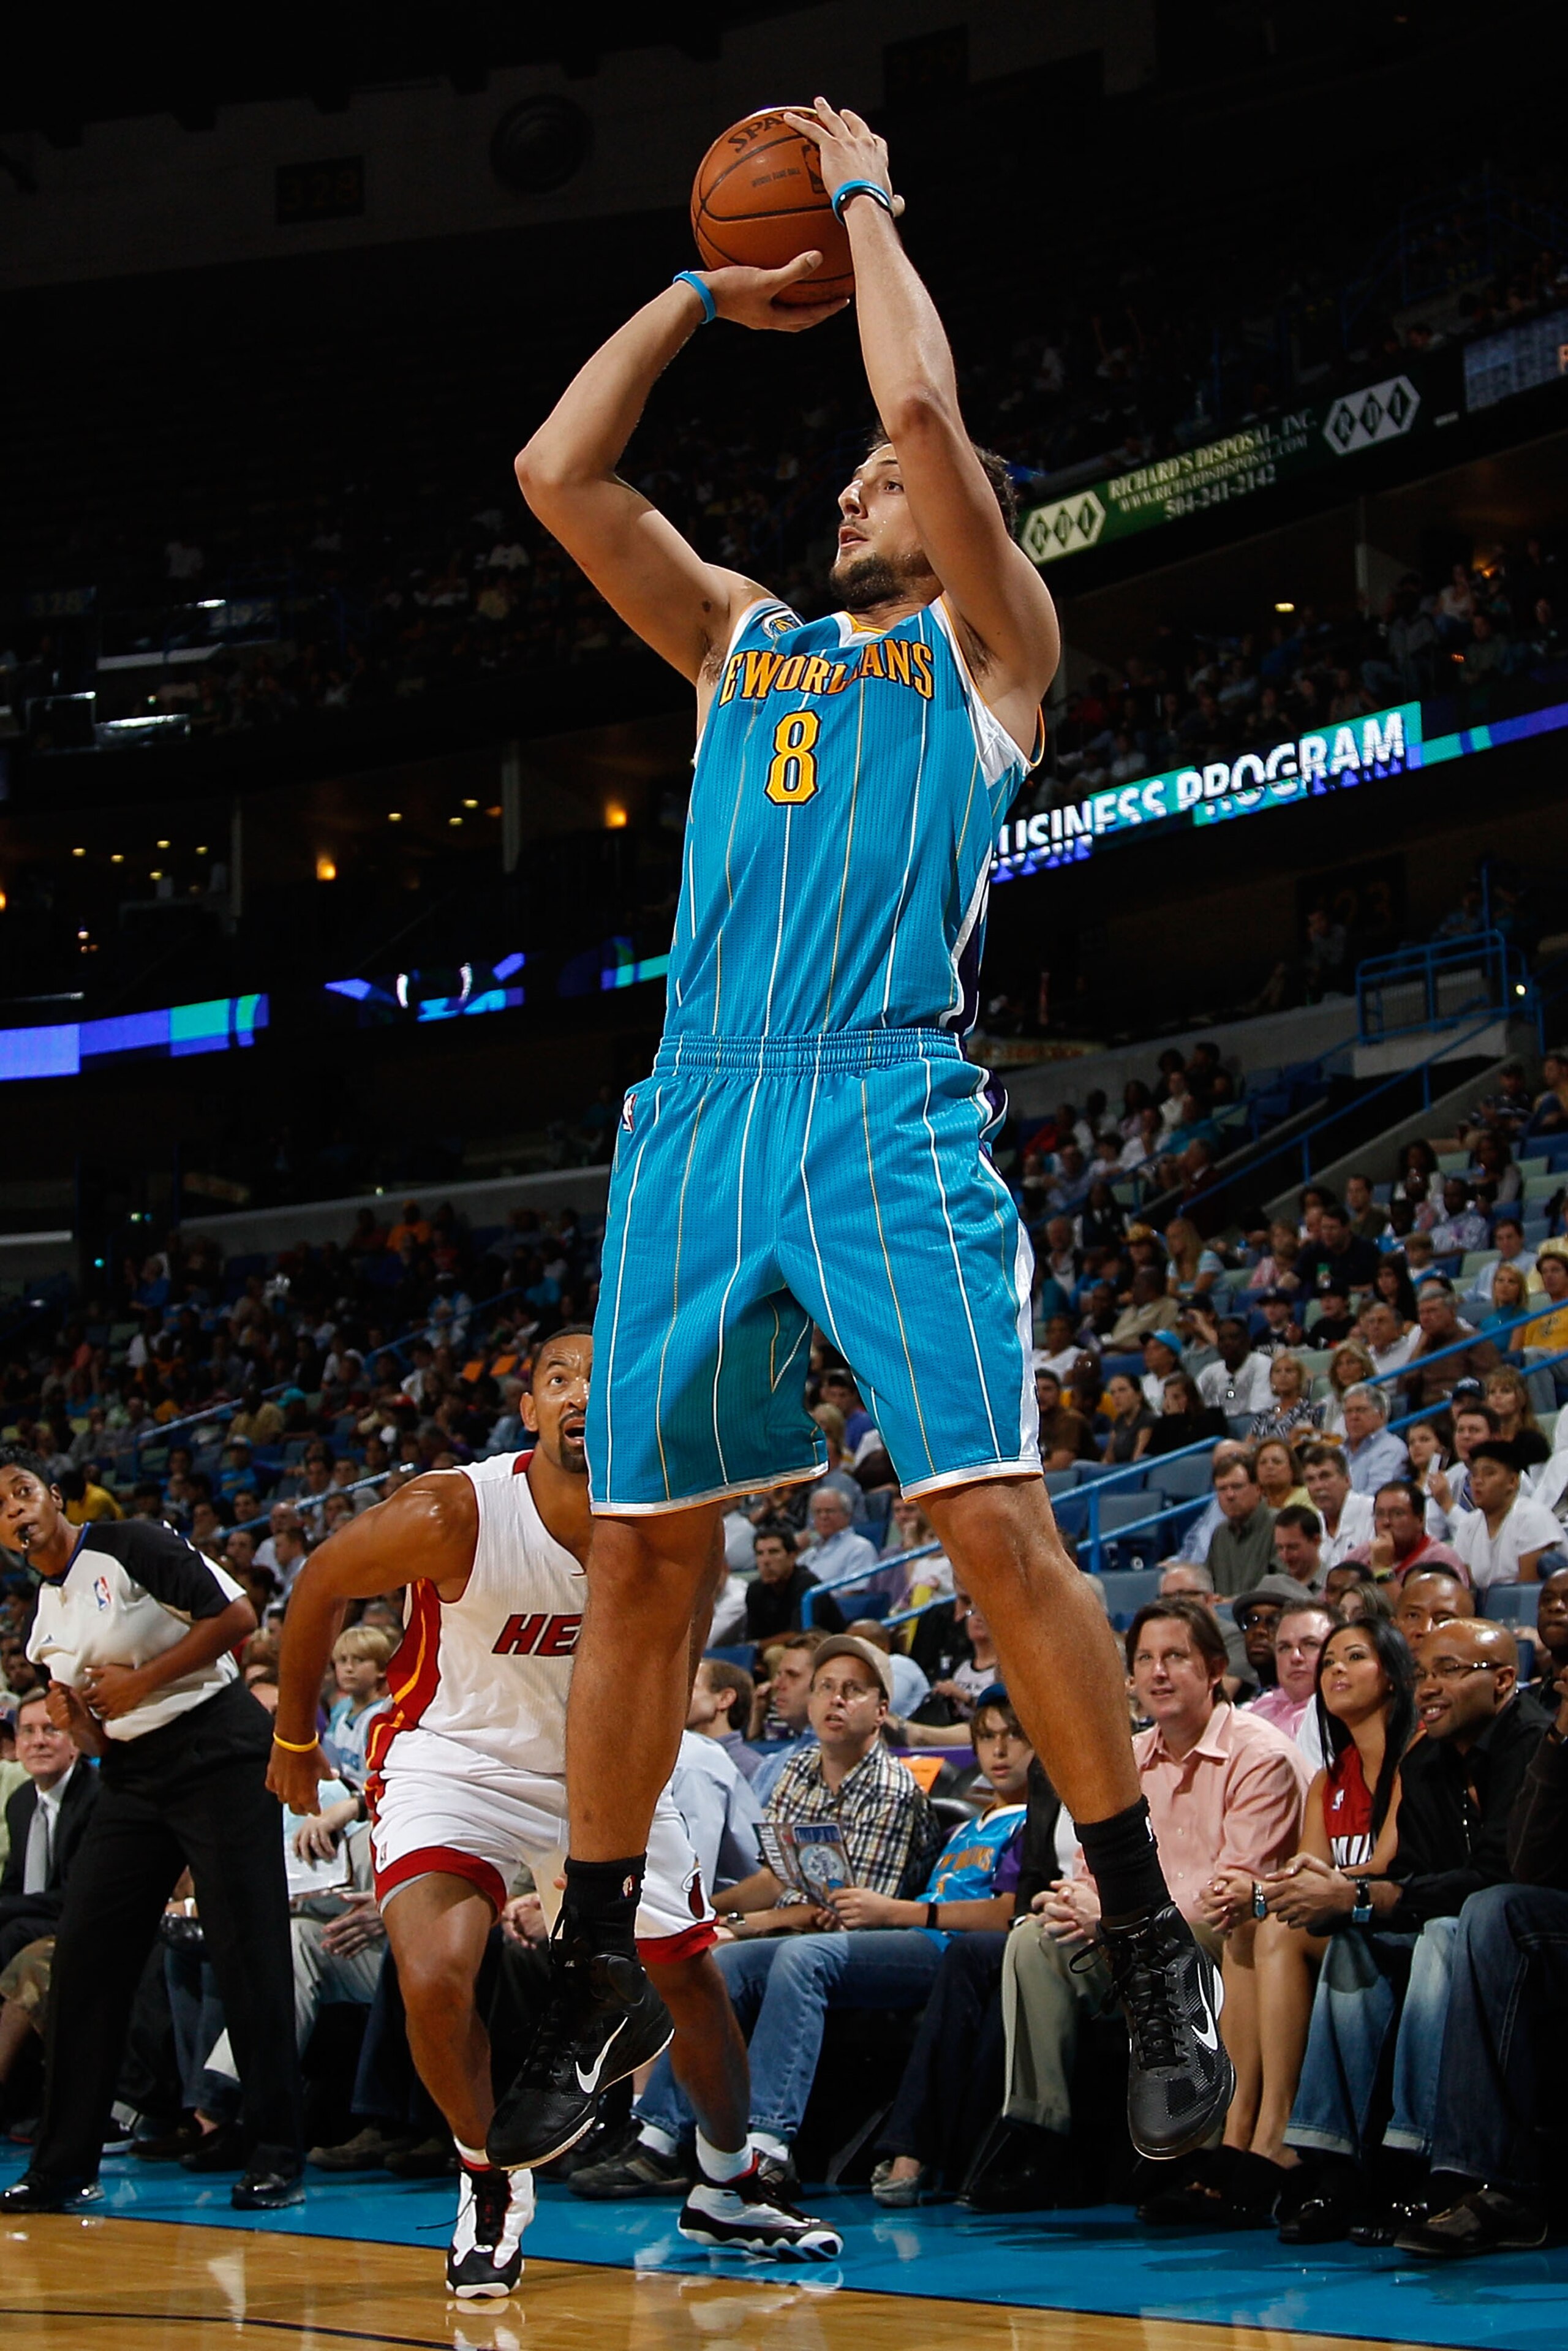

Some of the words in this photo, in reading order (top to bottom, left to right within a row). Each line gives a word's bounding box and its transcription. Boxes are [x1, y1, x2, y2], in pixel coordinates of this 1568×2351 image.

[763, 709, 821, 806] 8
[1176, 711, 1404, 817] PROGRAM
[490, 1612, 582, 1657] HE
